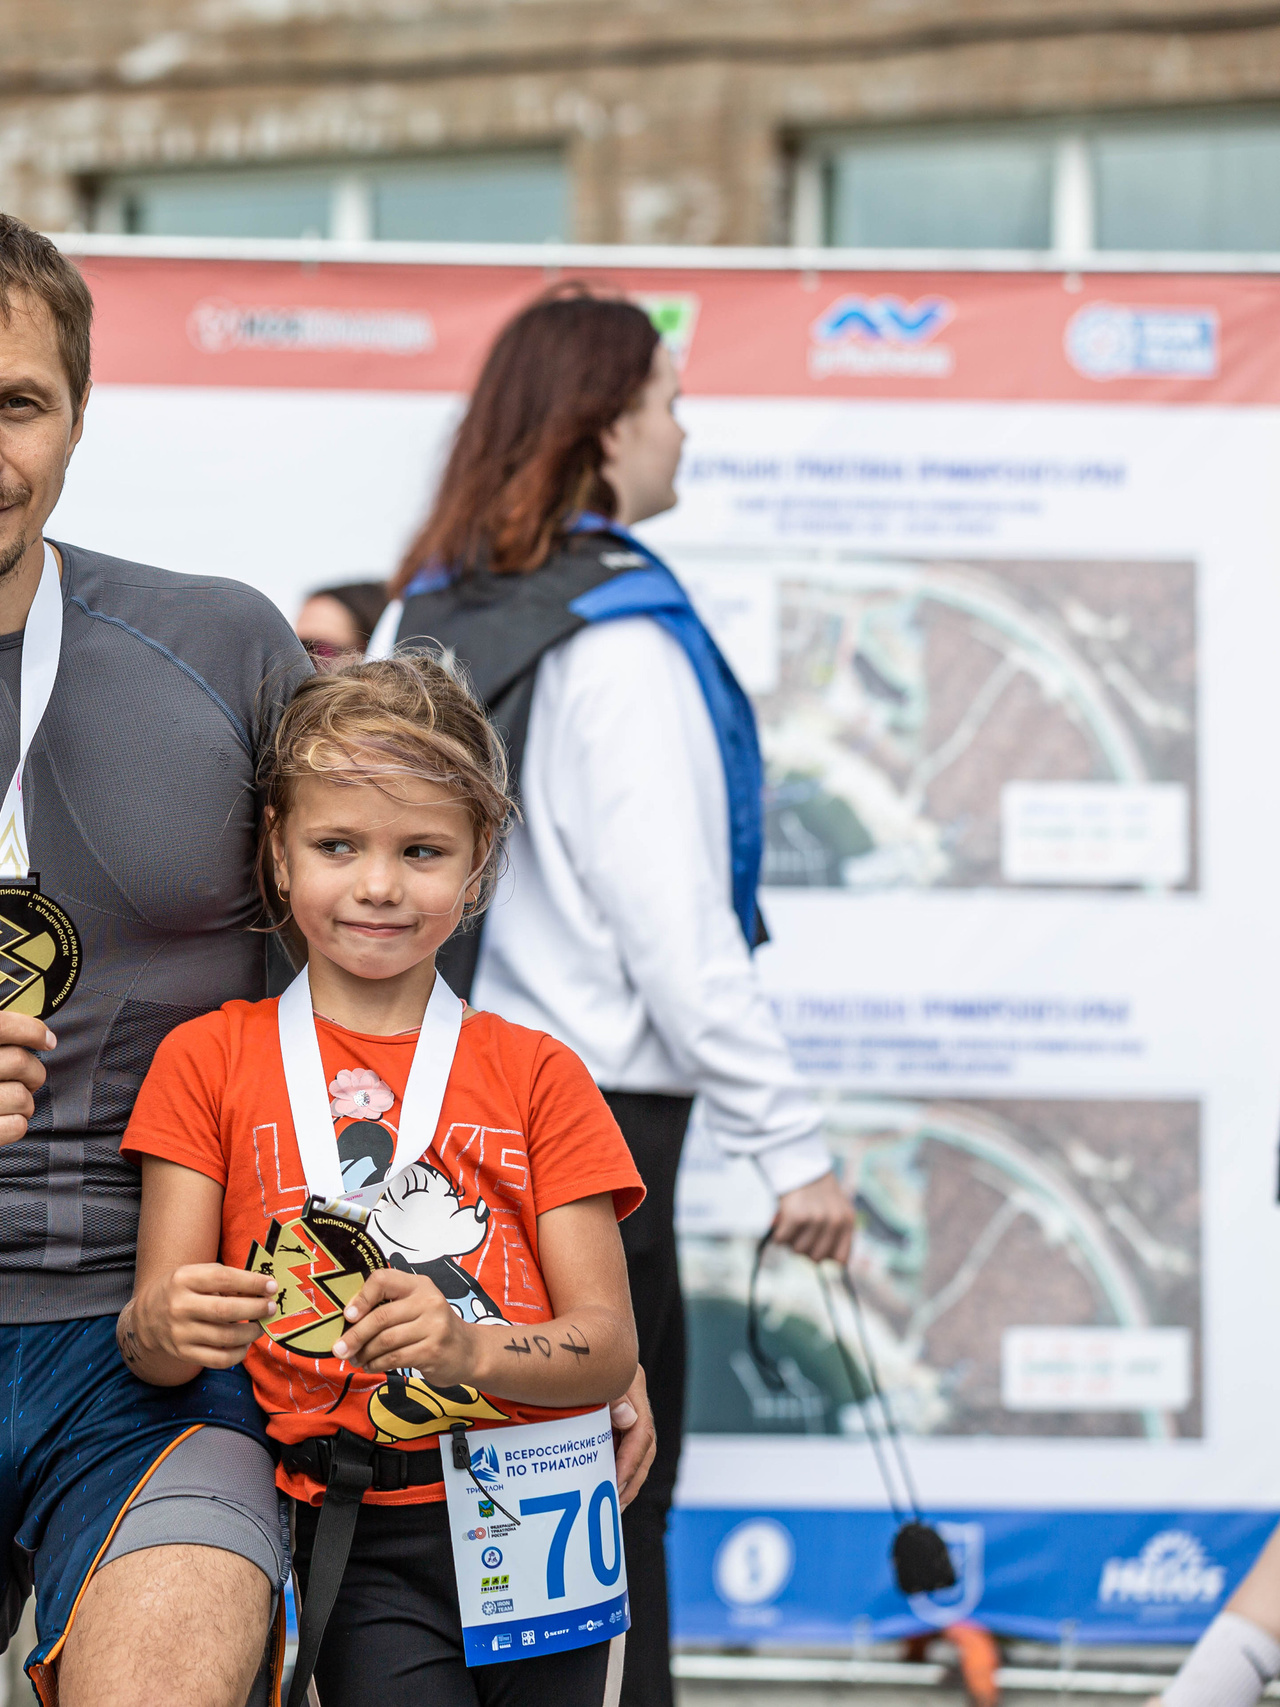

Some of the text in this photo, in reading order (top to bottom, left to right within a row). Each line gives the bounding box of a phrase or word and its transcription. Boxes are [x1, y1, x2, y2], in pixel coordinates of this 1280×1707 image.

[32, 893, 74, 935] ПРИМОРСКОГО
[35, 905, 69, 956] ВЛАДИВОСТОК
[69, 935, 78, 955] КРАЯ
[71, 956, 78, 968] ПО
[51, 969, 77, 1008] ТРИАТЛОНУ
[312, 1218, 385, 1270] ЧЕМПИОНАТ ПРИМОРСК
[505, 1437, 596, 1462] ВСЕРОССИЙСКИЕ
[506, 1450, 599, 1477] ПО ТРИАТЛОНУ
[466, 1484, 504, 1495] ТРИТЛОН
[549, 1628, 570, 1637] SCOTT
